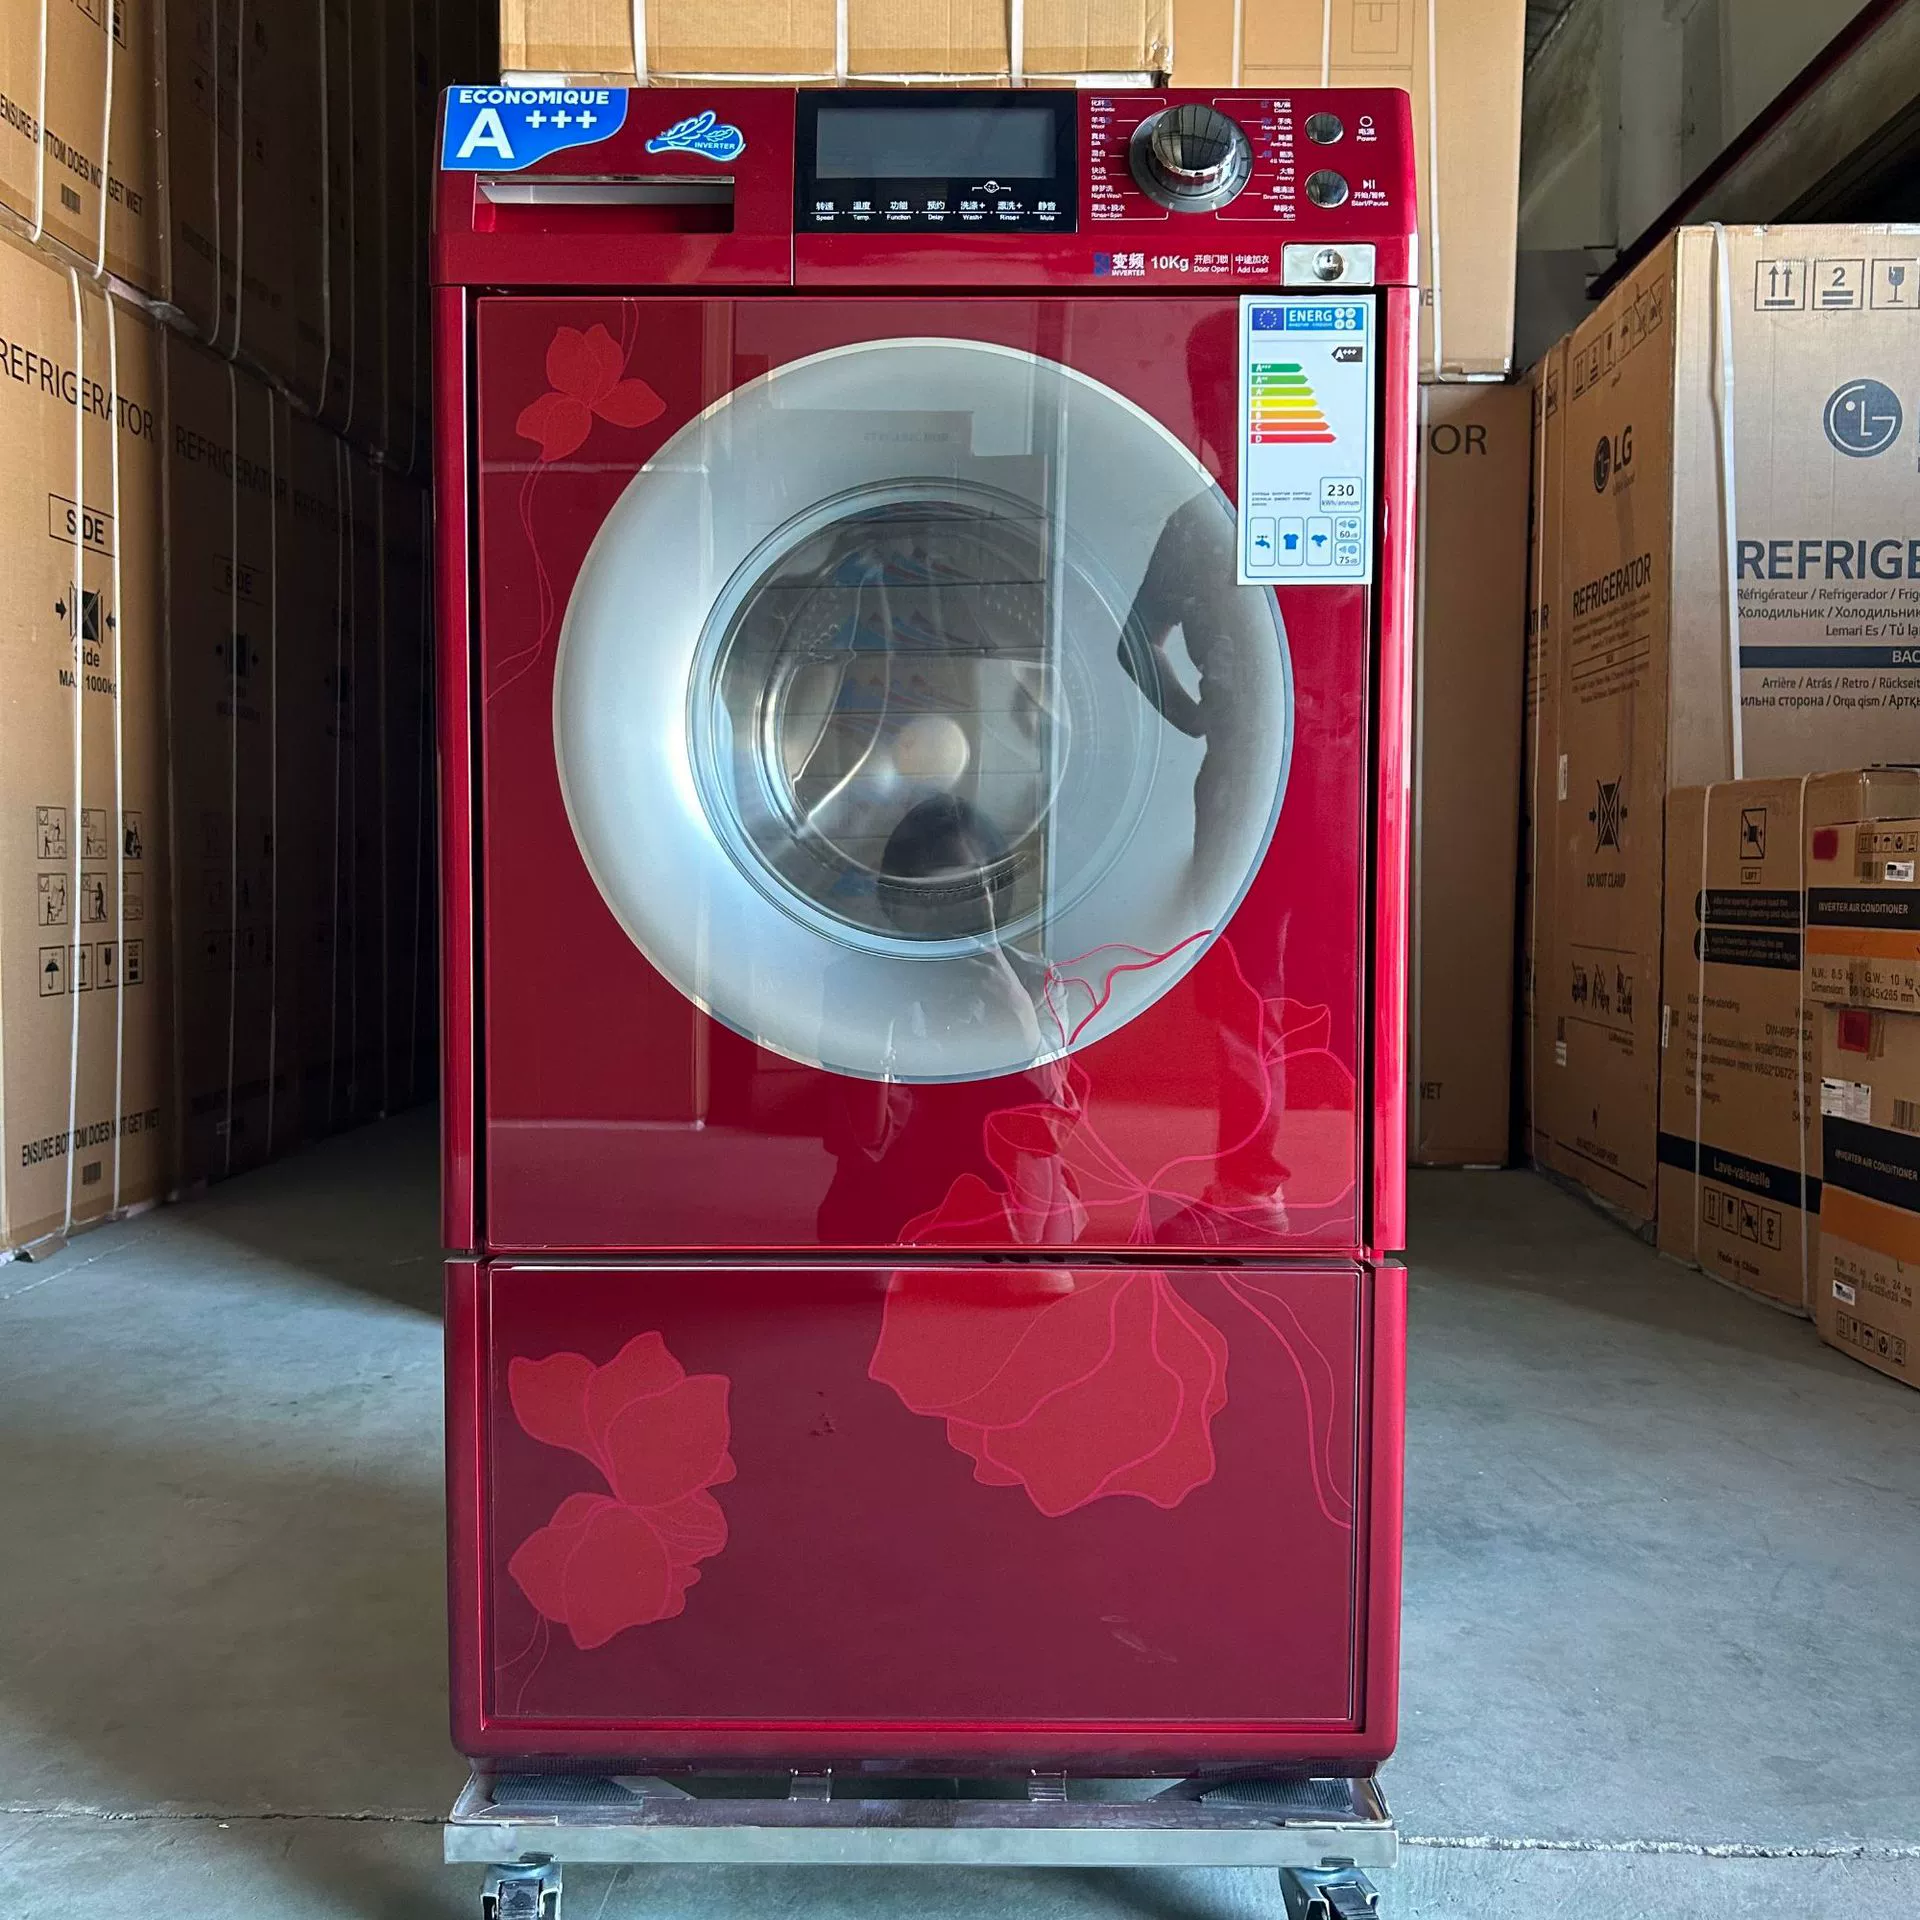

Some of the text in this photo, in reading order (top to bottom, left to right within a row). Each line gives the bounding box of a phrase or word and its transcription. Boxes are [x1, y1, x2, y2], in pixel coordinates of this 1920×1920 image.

[459, 90, 609, 105] ECONOMIQUE
[456, 108, 515, 159] A
[694, 142, 736, 150] INVERTER
[1, 93, 143, 216] ENSURE BTTOM DOES NO GET WET
[1354, 191, 1386, 199] 开始/暂停
[816, 201, 834, 210] 转速
[853, 201, 871, 210] 温度
[890, 201, 908, 210] 功能
[1112, 253, 1145, 270] 变频
[1151, 255, 1189, 272] 10Kg
[1194, 254, 1228, 264] 开启门锁
[1235, 254, 1269, 264] 中途加衣
[1193, 265, 1229, 273] Door Open
[1289, 310, 1333, 321] ENERG
[1256, 423, 1262, 431] C
[1256, 435, 1262, 443] D
[1613, 424, 1632, 475] LG
[1327, 485, 1355, 497] 230
[67, 509, 104, 545] SDE
[1572, 552, 1651, 619] REFRIGERATOR
[1737, 588, 1808, 602] Réfrigérateur
[1819, 588, 1888, 602] Refrigerador
[1738, 607, 1824, 620] Холодильник
[1826, 625, 1862, 636] Lemari
[1866, 625, 1878, 636] Es
[74, 642, 100, 667] ide
[59, 669, 78, 687] MA
[1762, 677, 1796, 689] Arrière
[1806, 677, 1832, 689] Atrás
[1842, 677, 1869, 689] Retro
[1779, 696, 1823, 708] сторона
[1833, 695, 1856, 709] Orqa
[1858, 696, 1880, 709] qism
[1587, 872, 1595, 888] DO
[1595, 872, 1607, 888] NOT
[1818, 902, 1909, 914] INVERTER AIR CONDITIONER
[1891, 974, 1900, 985] 10
[22, 1137, 54, 1167] ENSURE
[88, 1121, 110, 1146] DOES
[128, 1112, 143, 1134] GET
[144, 1108, 160, 1131] WET
[1862, 1157, 1872, 1168] AIR
[1873, 1160, 1918, 1181] CONDITIONER
